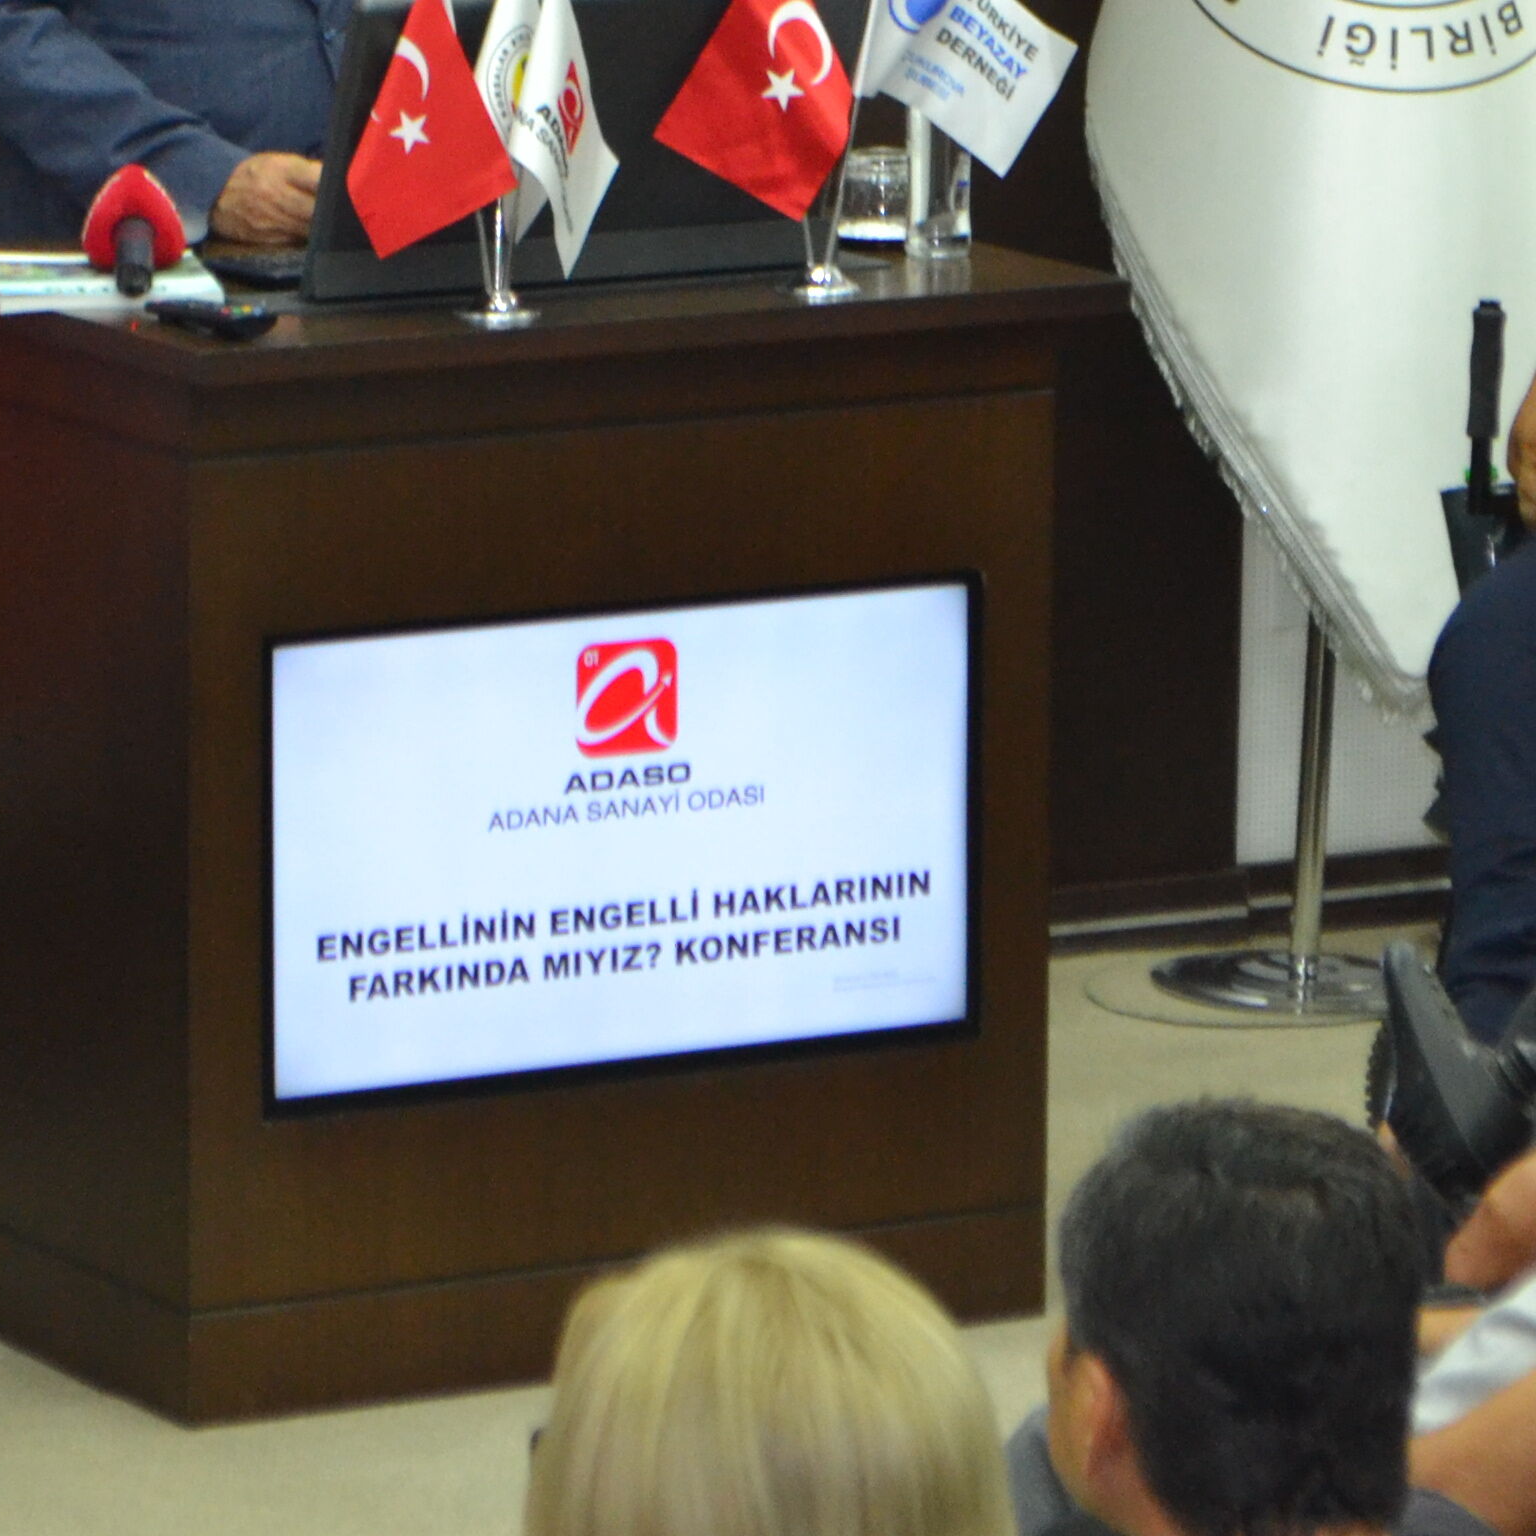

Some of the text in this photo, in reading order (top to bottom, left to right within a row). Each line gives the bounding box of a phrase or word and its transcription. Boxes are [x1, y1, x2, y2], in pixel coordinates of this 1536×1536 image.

[935, 26, 1016, 102] DERNEĞİ
[948, 4, 1029, 81] BEYAZAY
[487, 784, 766, 833] ADANA SANAYİ ODASI
[563, 761, 692, 796] ADASO
[316, 869, 931, 963] ENGELLİNİN ENGELLİ HAKLARININ
[348, 915, 901, 1003] FARKINDA MIYIZ? KONFERANSI
